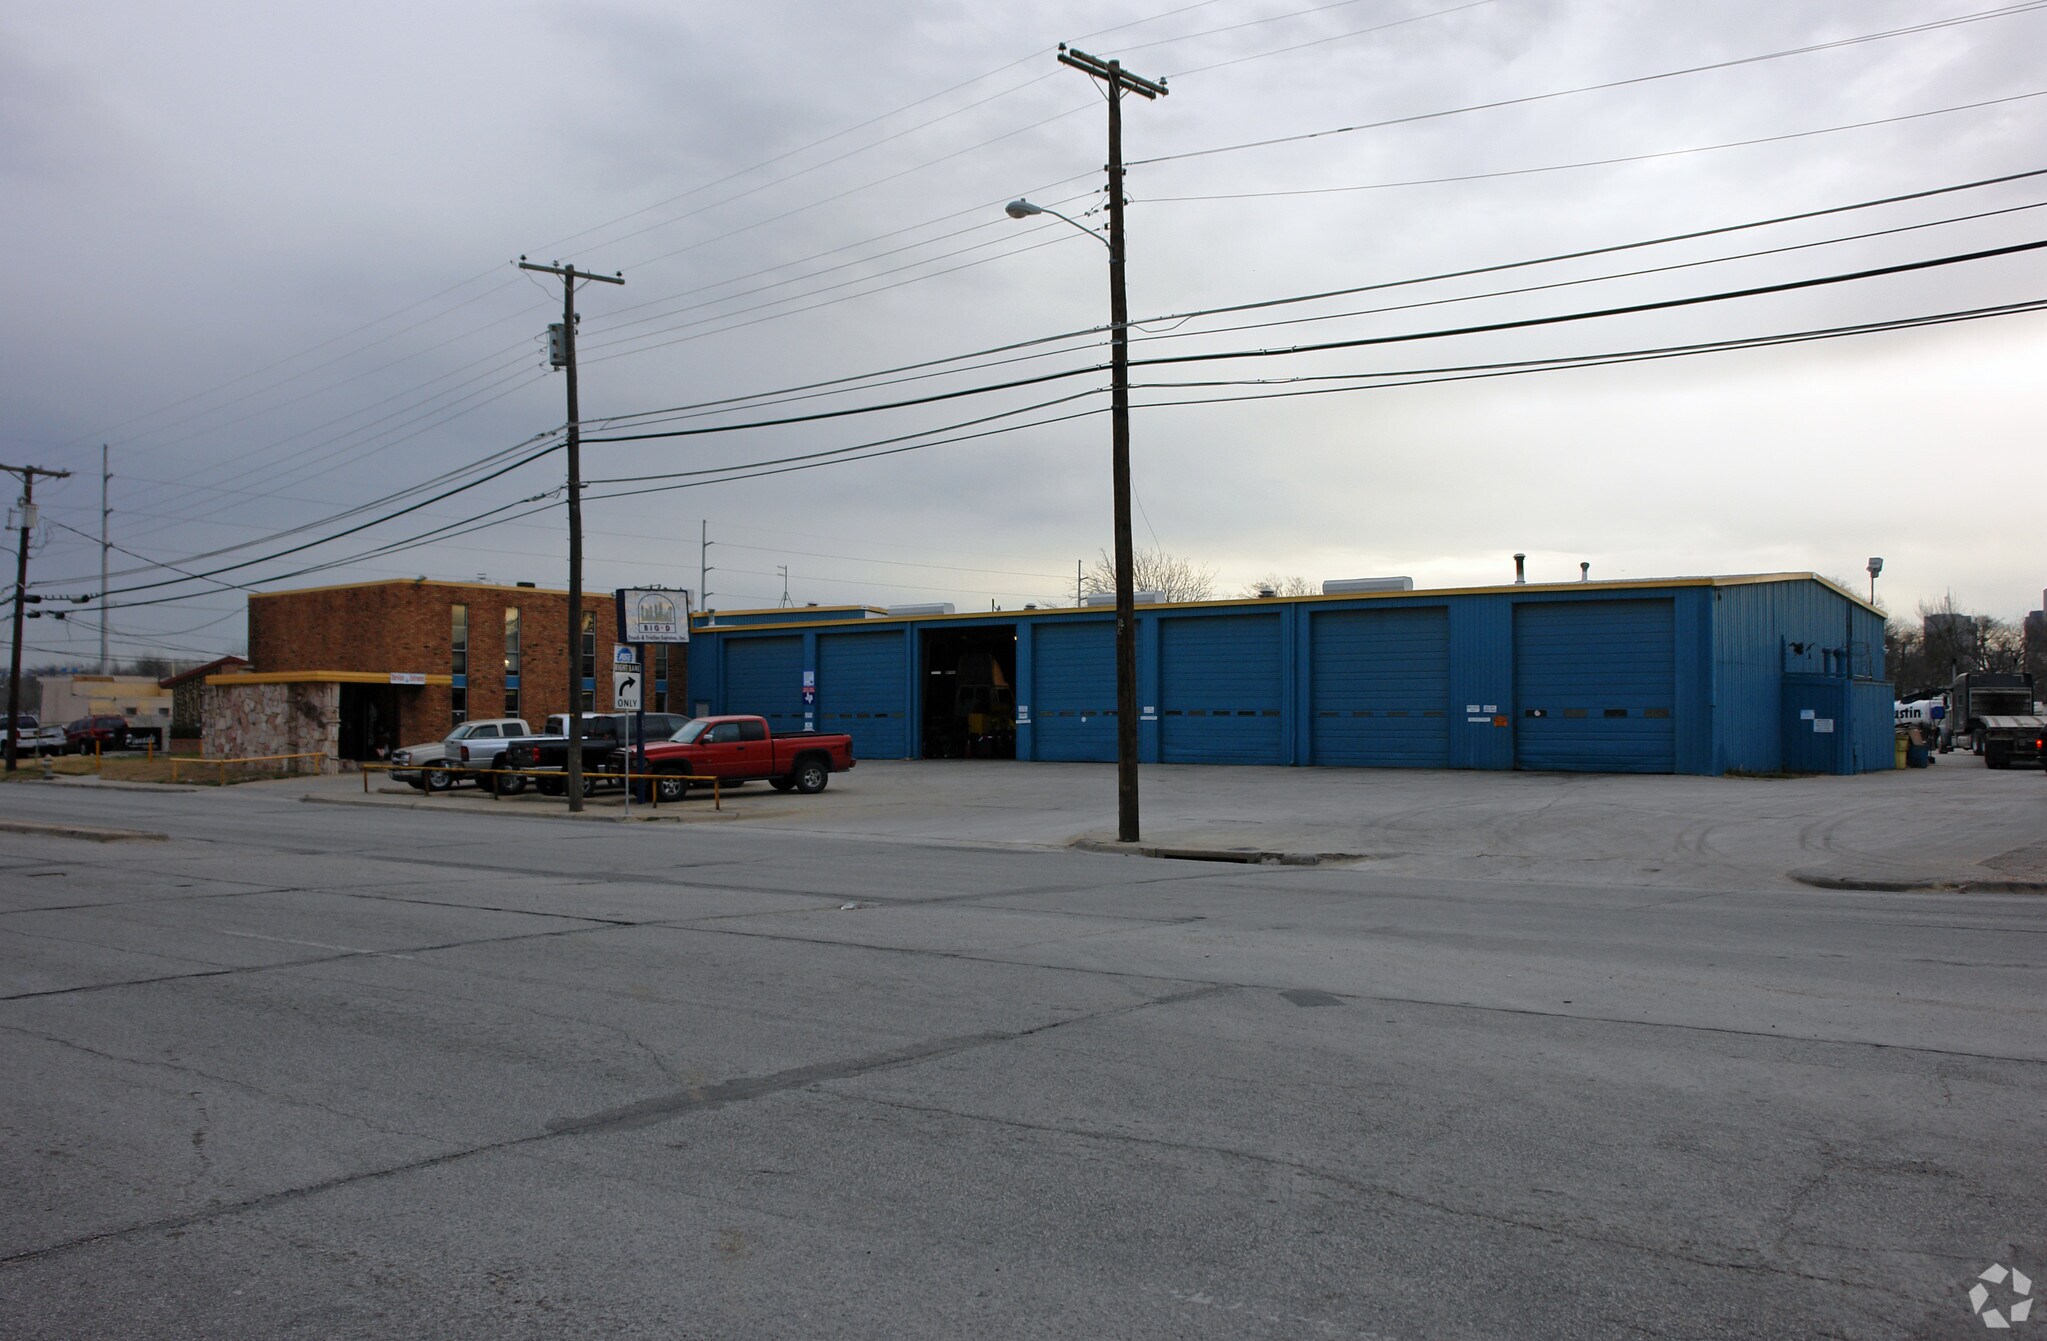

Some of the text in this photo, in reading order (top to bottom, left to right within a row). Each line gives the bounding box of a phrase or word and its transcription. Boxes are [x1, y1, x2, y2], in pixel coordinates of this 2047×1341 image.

[615, 664, 641, 672] RIGHT LANE
[618, 699, 637, 707] ONLY
